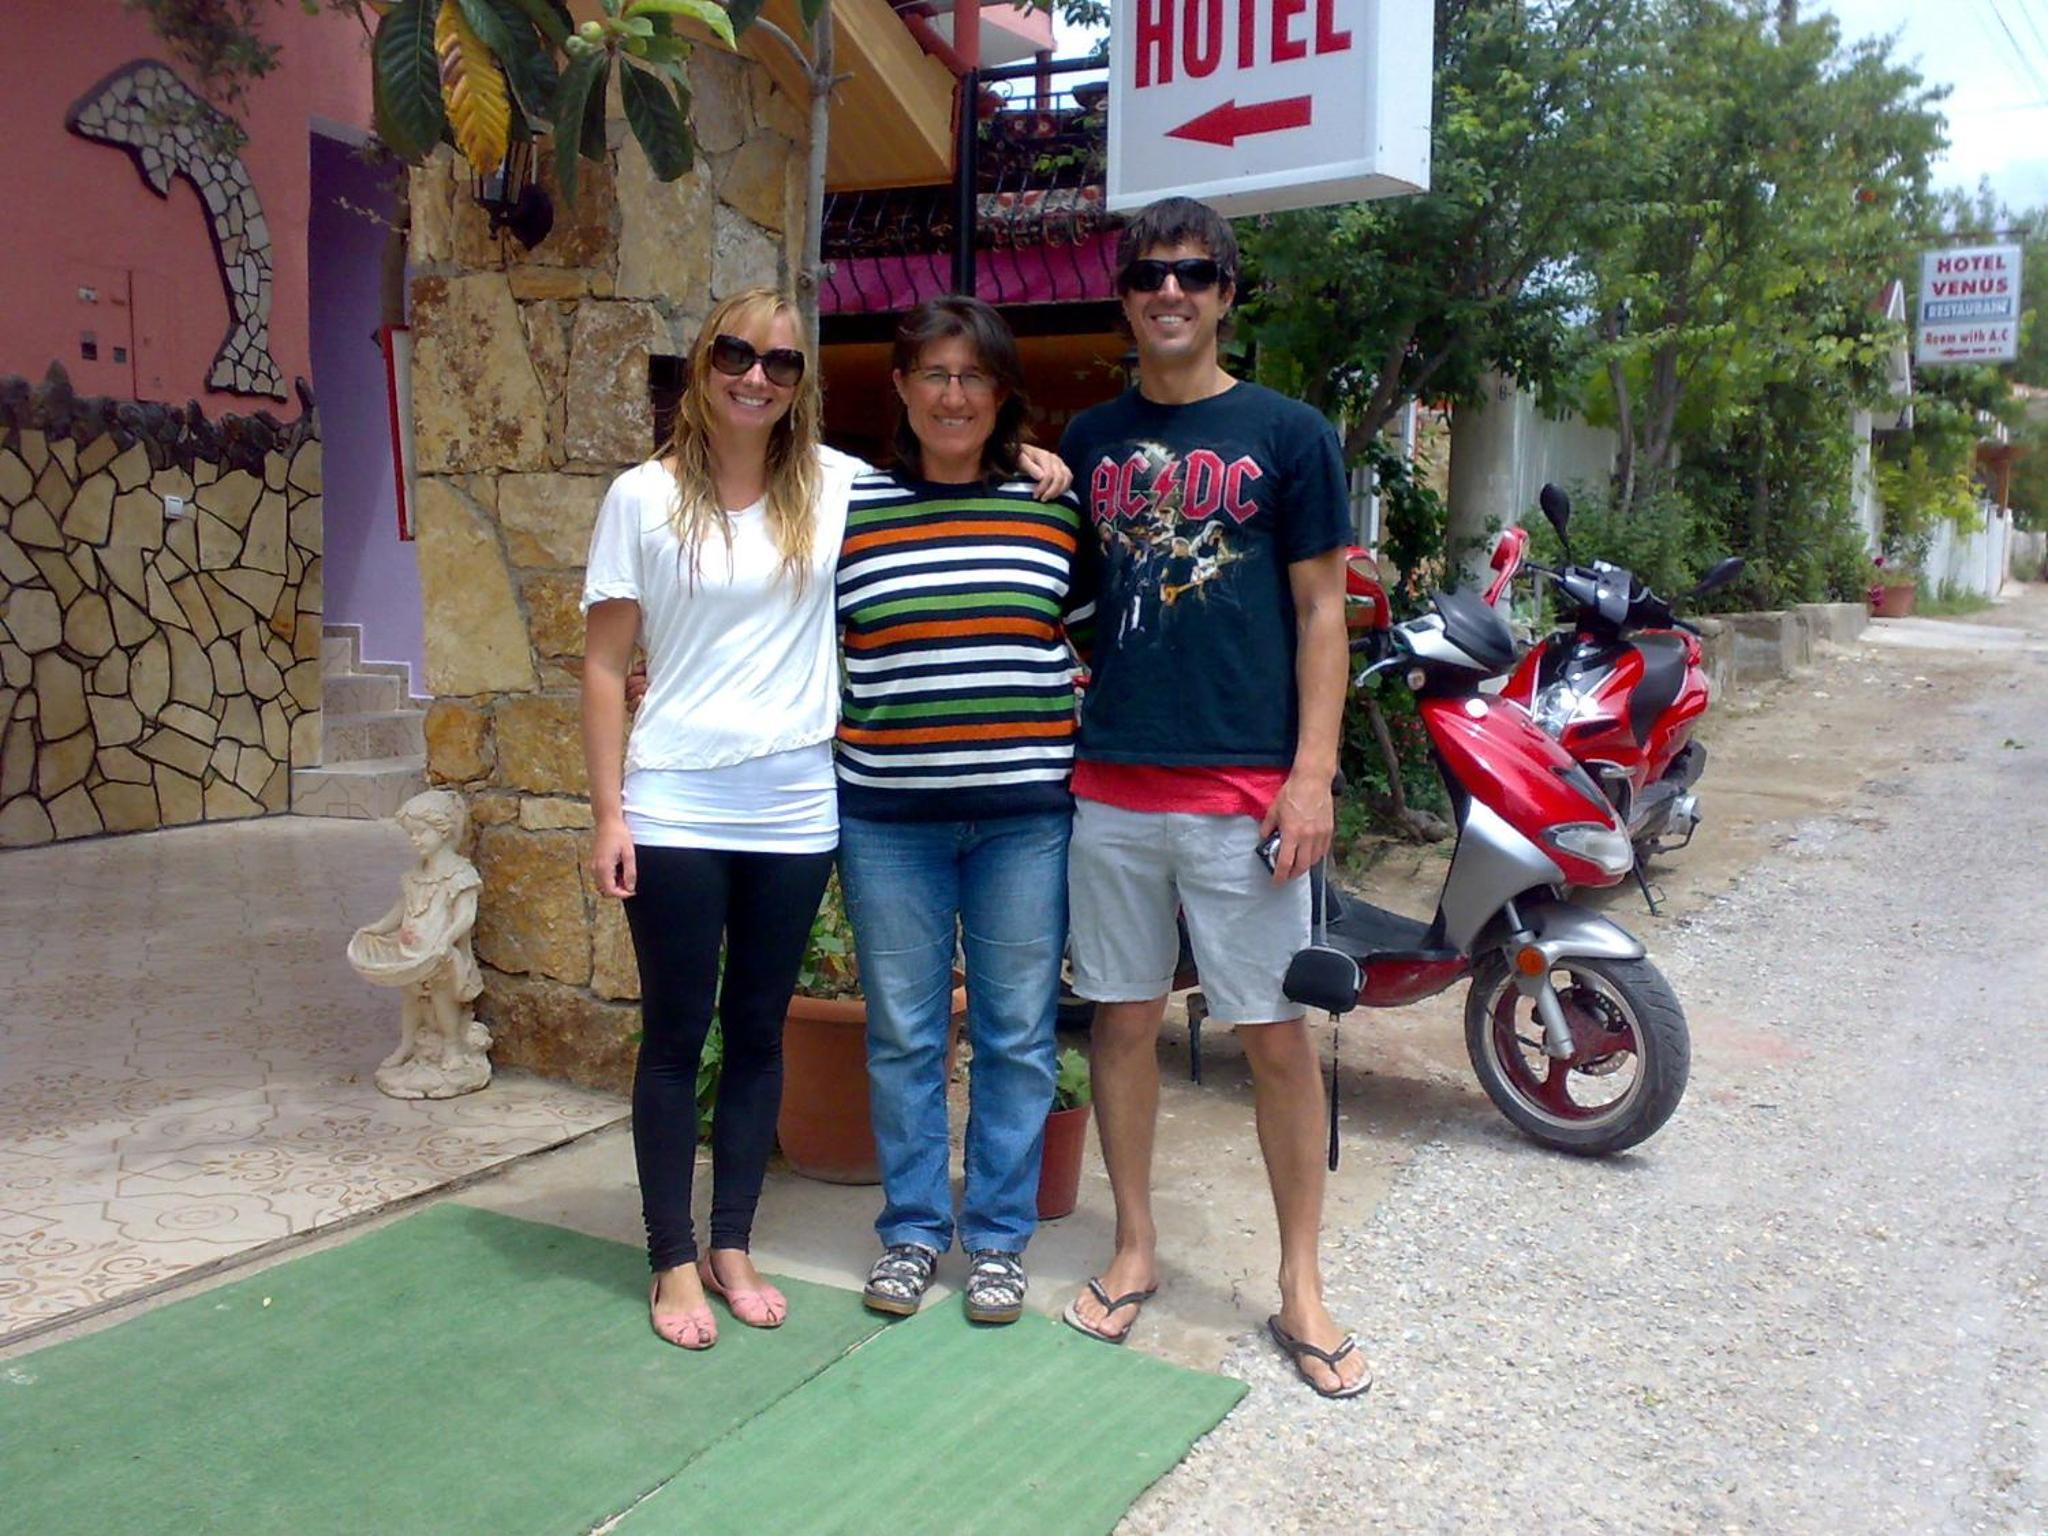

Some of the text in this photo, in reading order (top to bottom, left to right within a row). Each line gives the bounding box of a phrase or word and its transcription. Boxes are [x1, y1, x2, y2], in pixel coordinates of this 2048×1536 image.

[1135, 0, 1352, 89] HOTEL
[1937, 255, 2006, 274] HOTEL
[1931, 277, 2008, 296] VENUS
